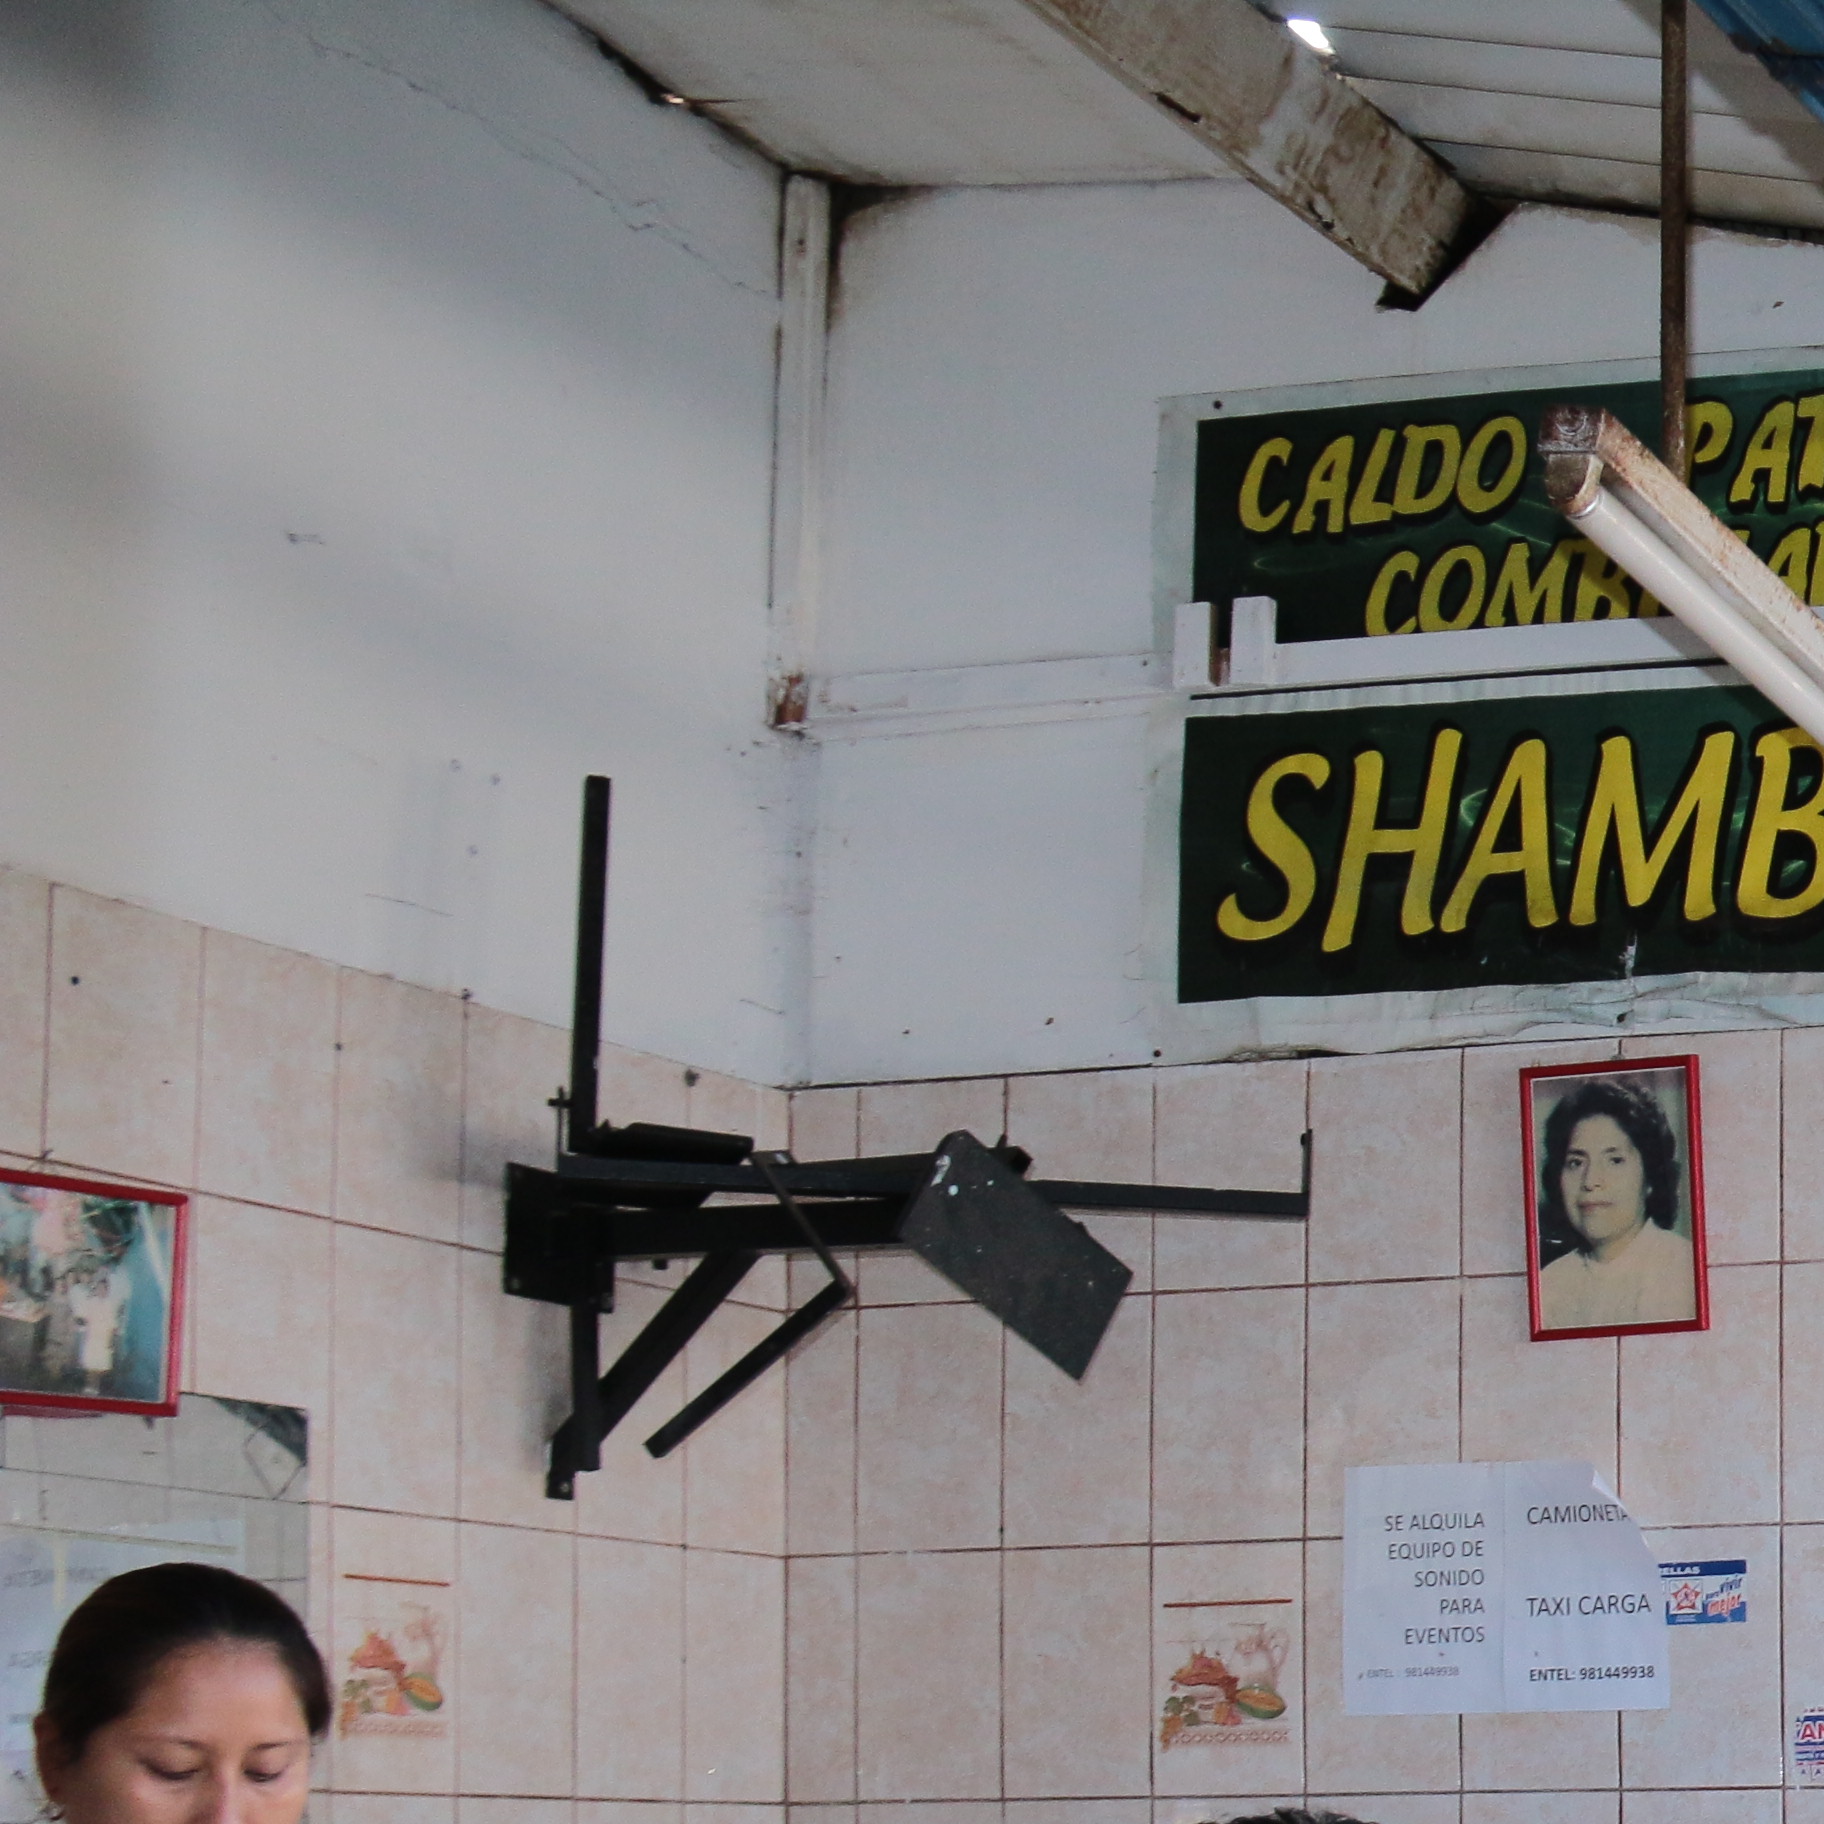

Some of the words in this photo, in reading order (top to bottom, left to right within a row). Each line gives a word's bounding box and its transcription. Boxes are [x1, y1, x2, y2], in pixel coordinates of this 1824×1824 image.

[1239, 415, 1528, 534] CALDO
[1384, 1514, 1404, 1532] SE
[1408, 1511, 1486, 1531] ALQUILA
[1388, 1540, 1456, 1562] EQUIPO
[1461, 1539, 1485, 1558] DE
[1414, 1568, 1485, 1588] SONIDO
[1439, 1597, 1486, 1615] PARA
[1526, 1597, 1571, 1618] TAXI
[1578, 1593, 1652, 1616] CARGA
[1404, 1626, 1486, 1645] EVENTOS
[1529, 1667, 1575, 1682] ENTEL:
[1579, 1665, 1656, 1681] 981449938
